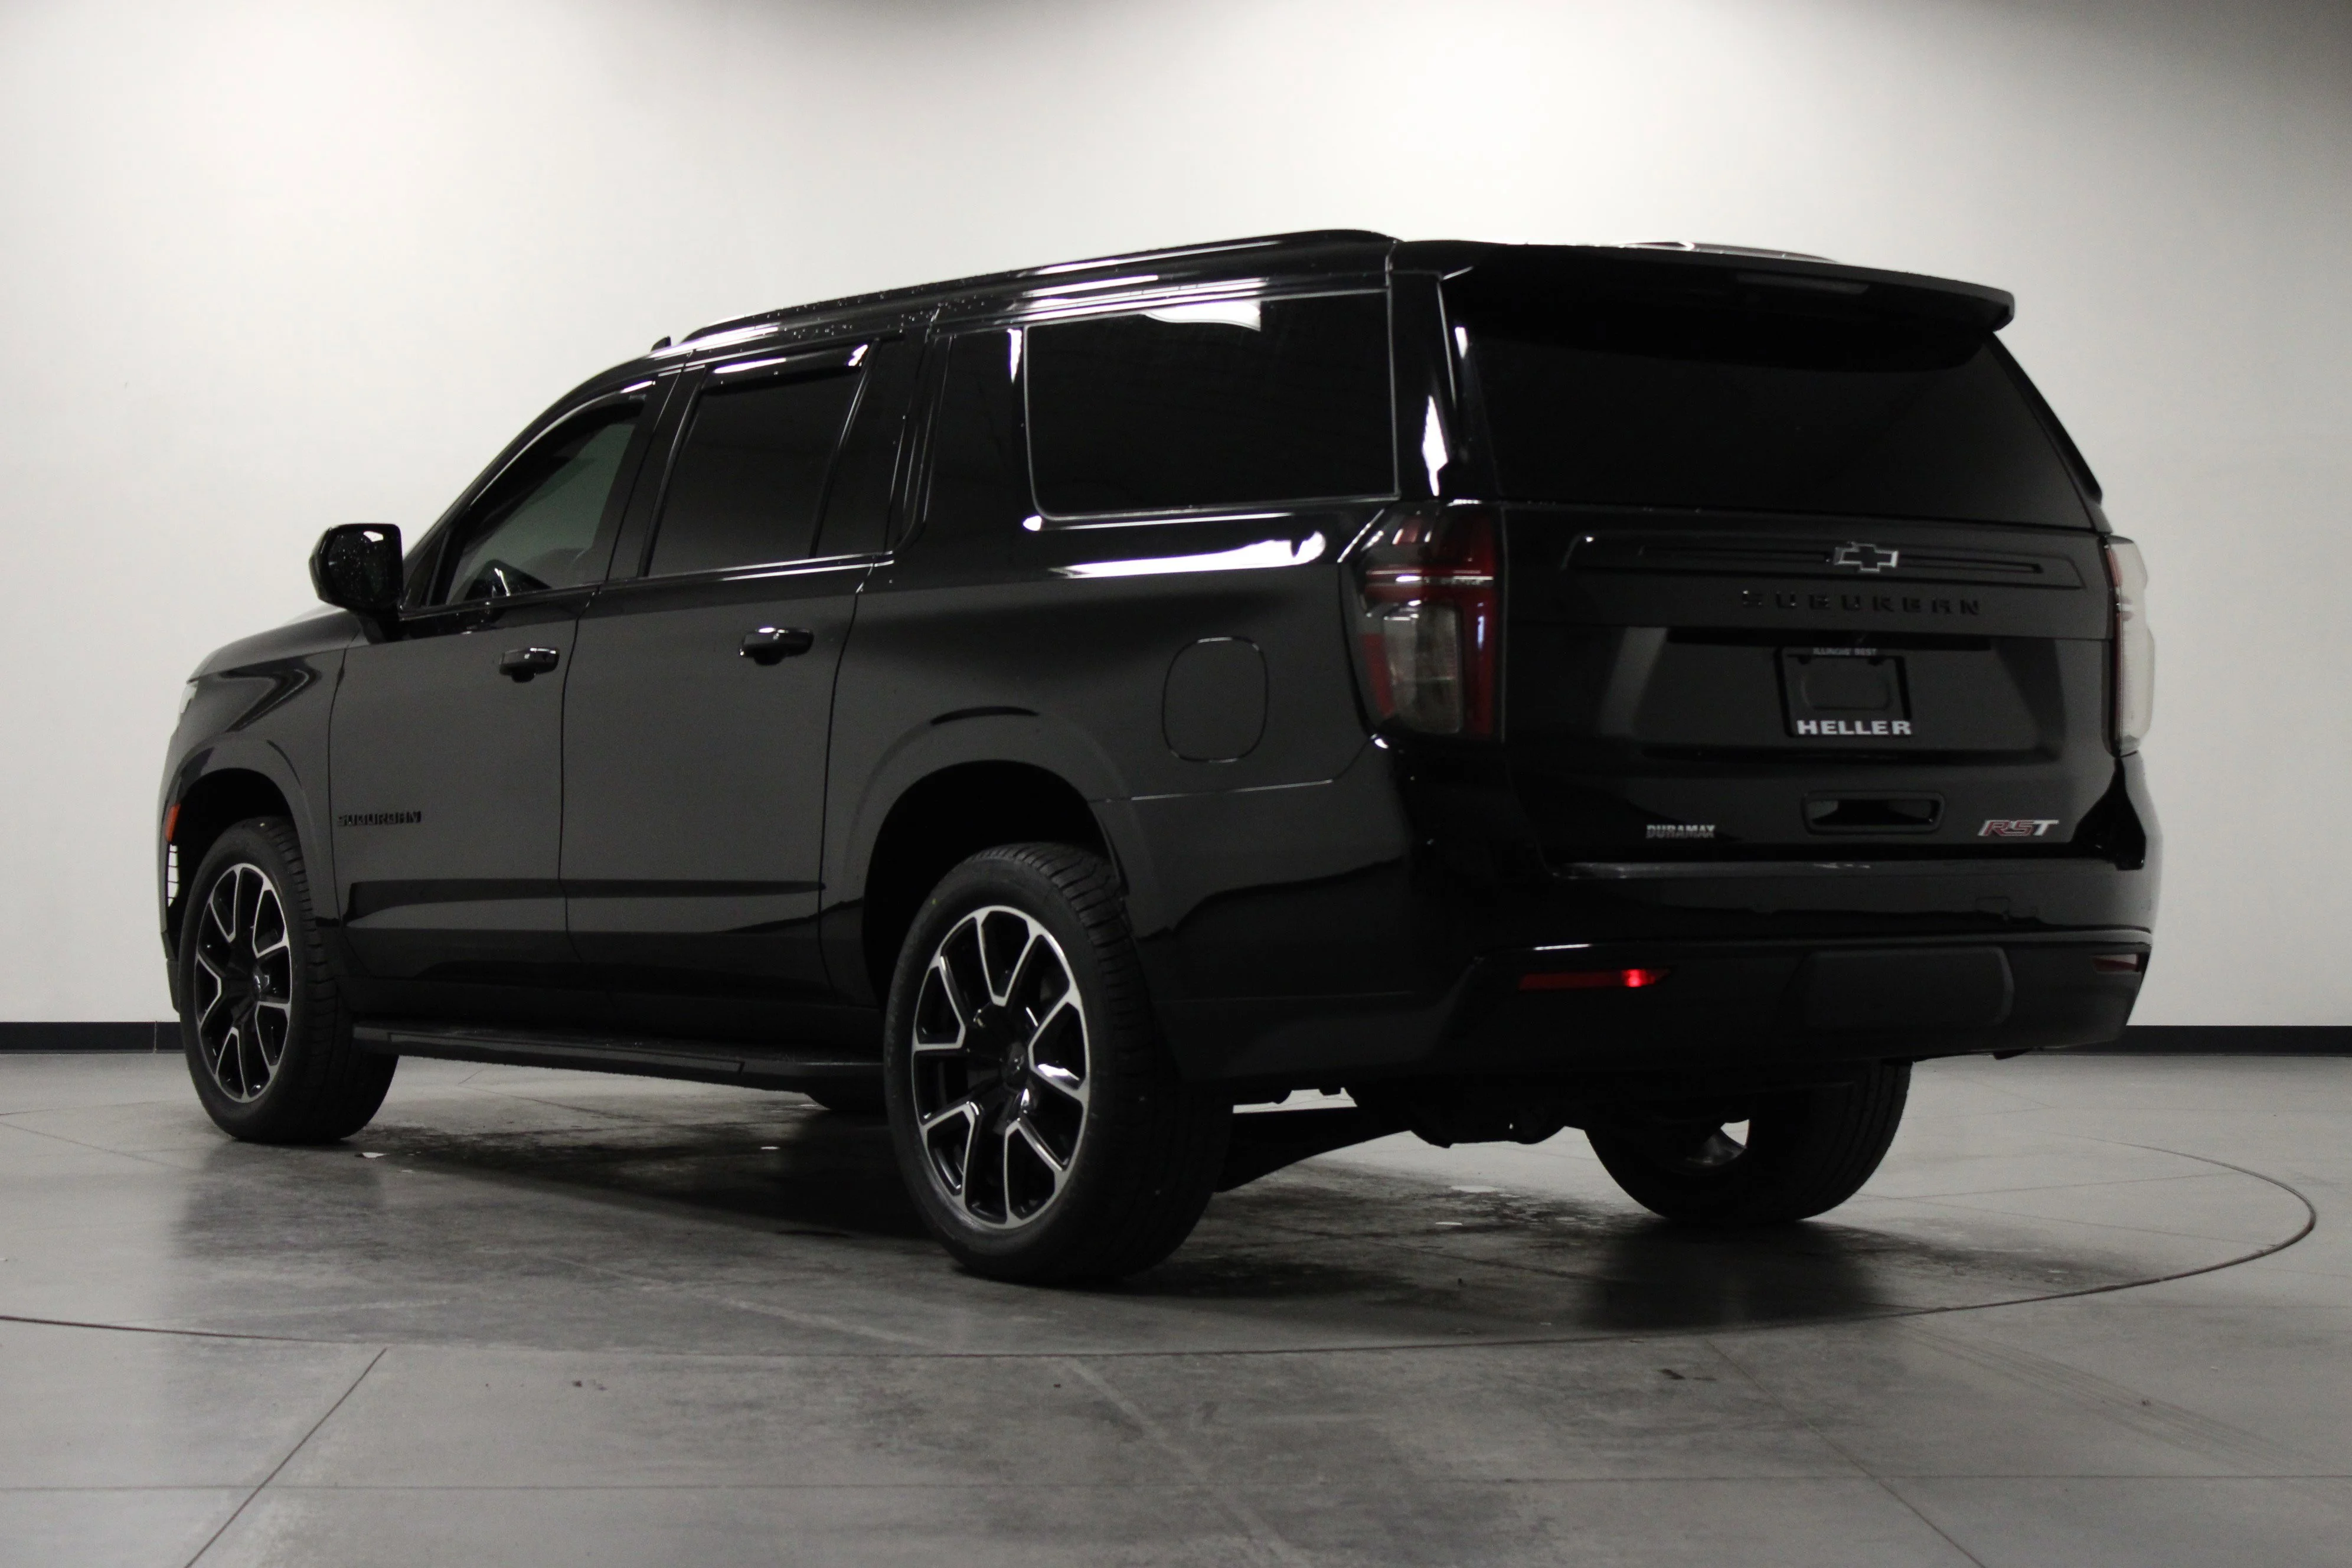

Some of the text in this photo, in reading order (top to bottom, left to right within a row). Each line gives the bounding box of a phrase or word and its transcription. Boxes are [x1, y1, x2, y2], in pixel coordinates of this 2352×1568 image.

[1742, 590, 1979, 615] SUBURBAN
[1796, 719, 1912, 736] HELLER
[1645, 824, 1716, 839] DURAMAX
[1977, 819, 2060, 837] RST
